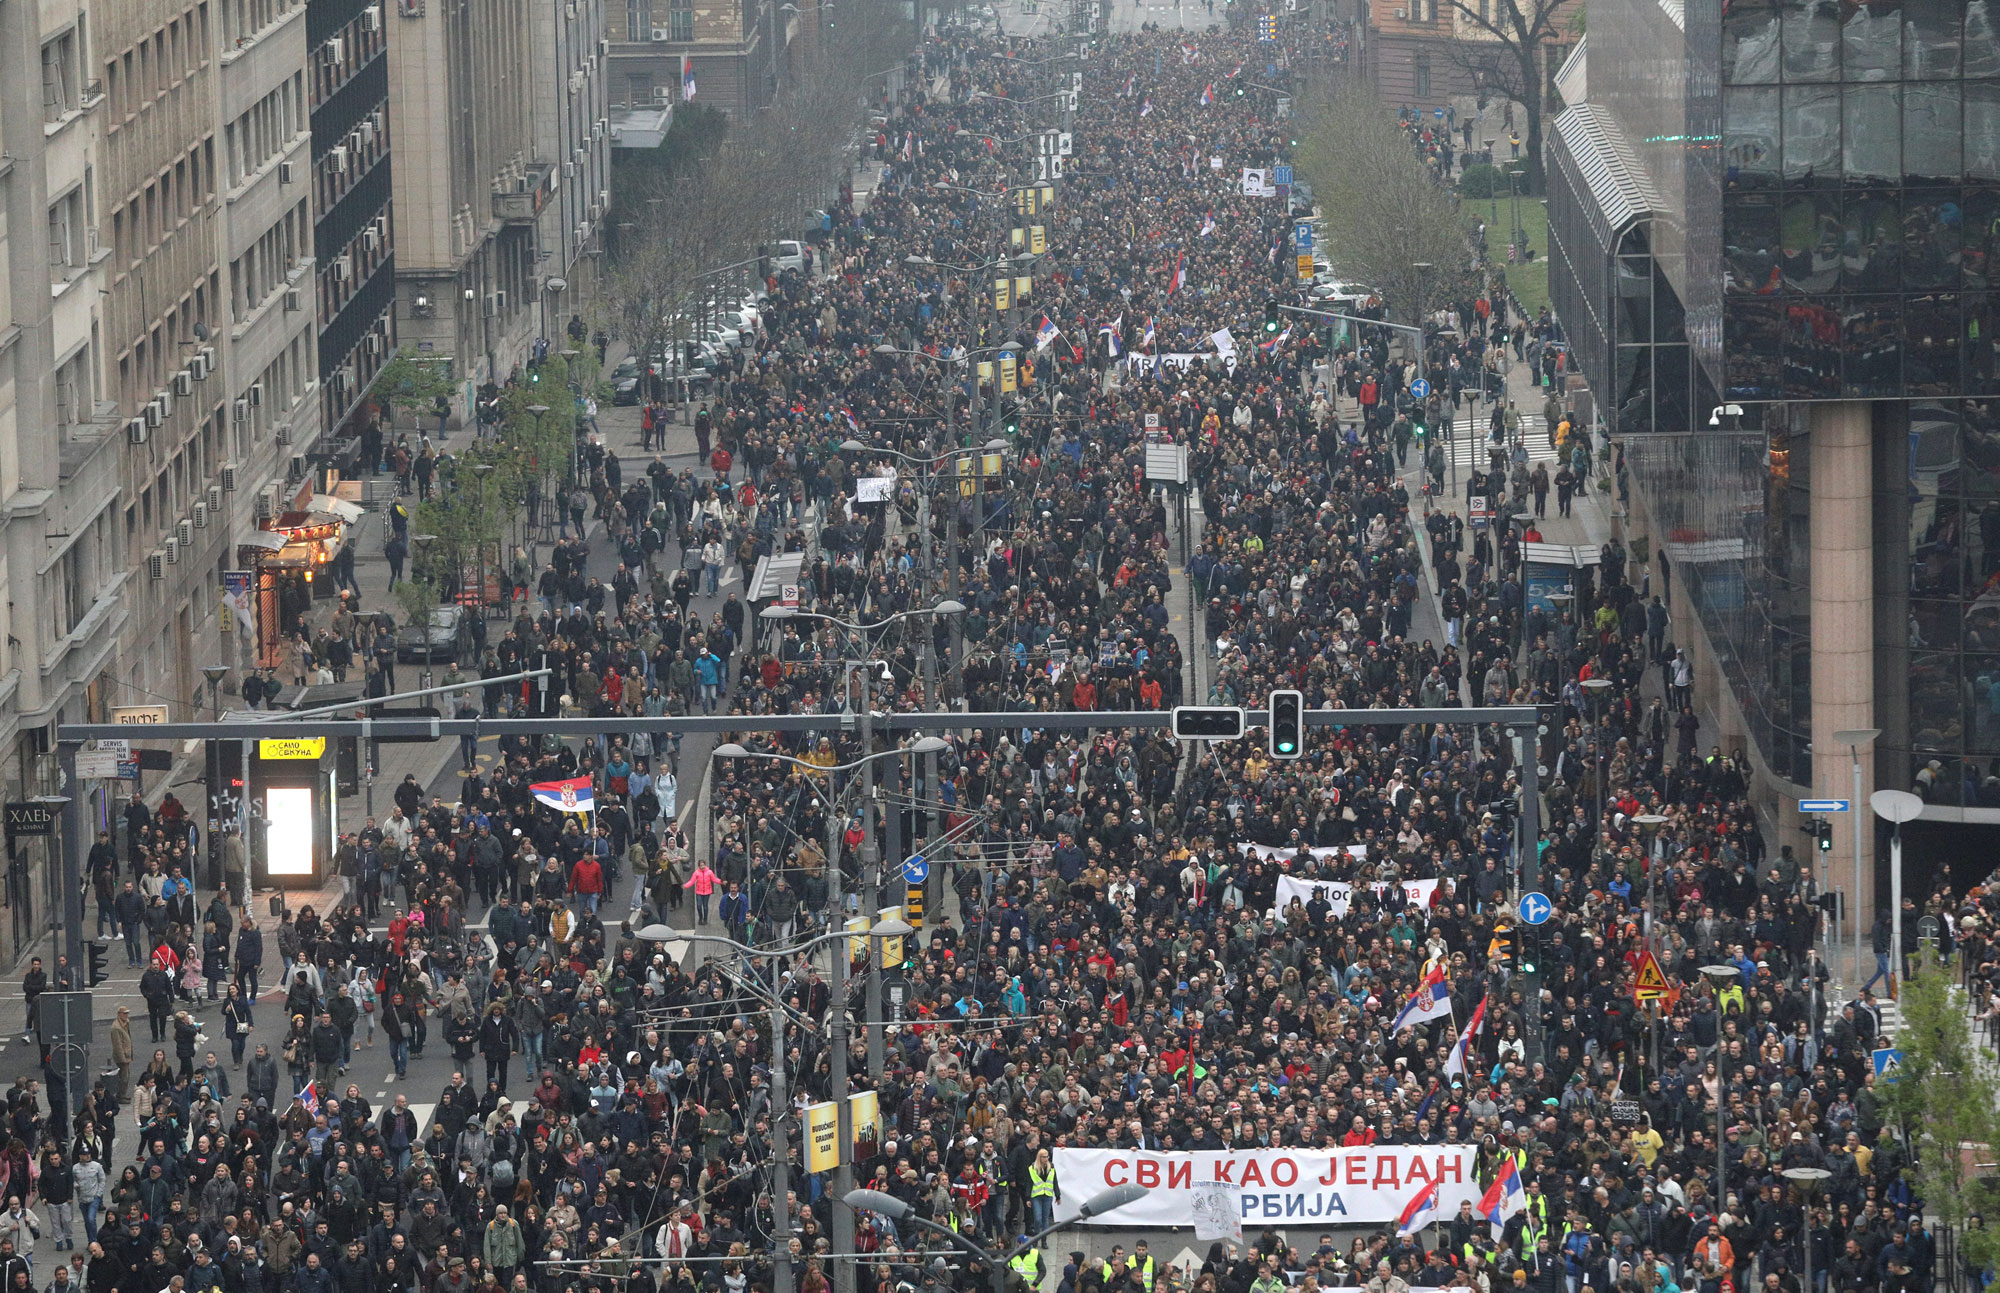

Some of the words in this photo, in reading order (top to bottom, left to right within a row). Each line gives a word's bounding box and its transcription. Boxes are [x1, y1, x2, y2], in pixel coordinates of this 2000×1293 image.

[820, 1144, 832, 1153] SADA
[1103, 1158, 1192, 1189] СВИ
[1214, 1157, 1299, 1187] КАО
[1319, 1154, 1462, 1190] ЈЕДАН
[1241, 1193, 1347, 1217] РБИЈА
